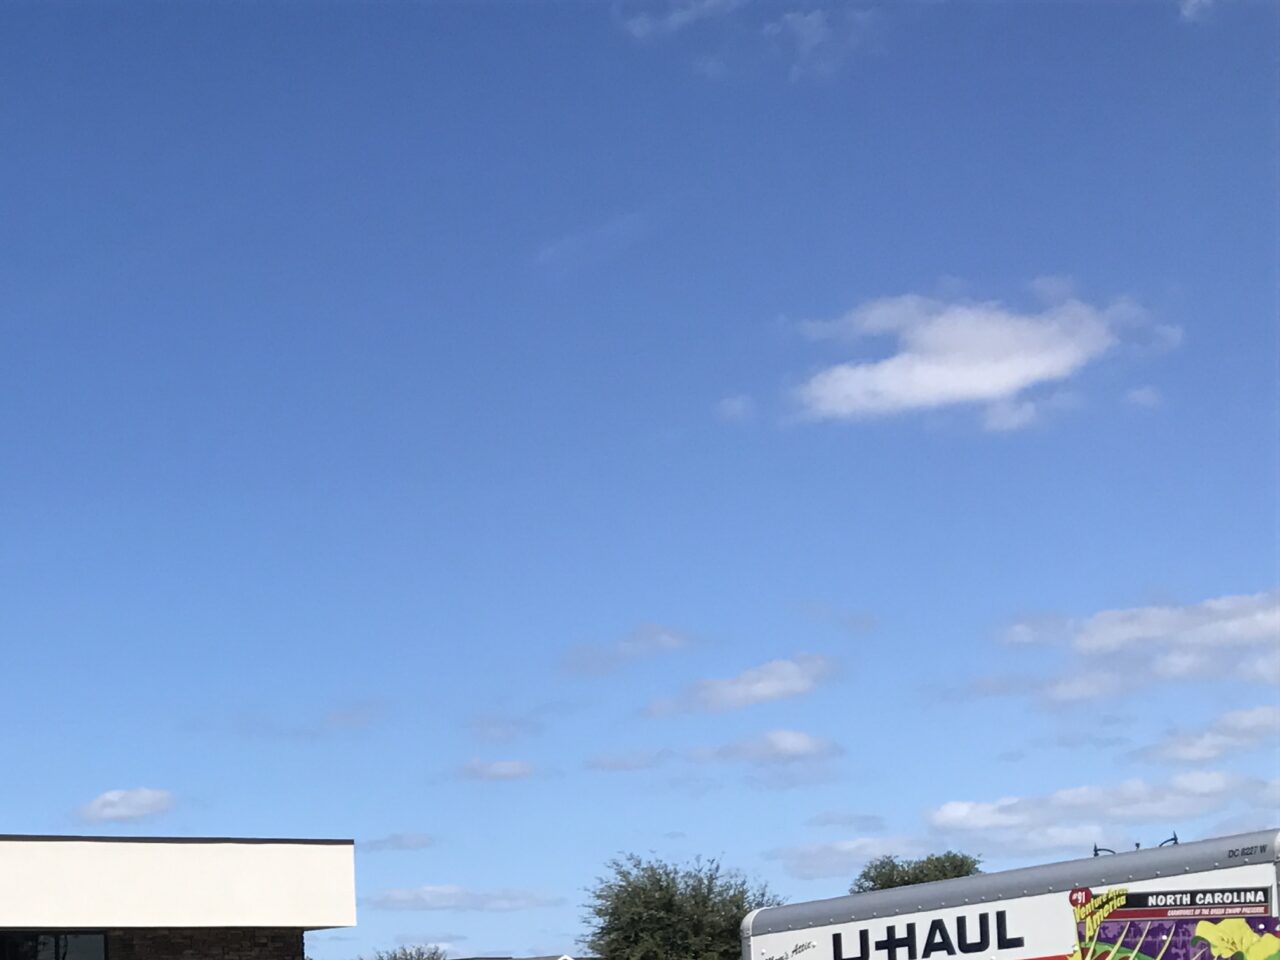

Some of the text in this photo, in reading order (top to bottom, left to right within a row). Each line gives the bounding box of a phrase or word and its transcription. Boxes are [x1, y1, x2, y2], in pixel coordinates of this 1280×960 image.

[1228, 848, 1239, 858] DC
[1148, 891, 1265, 907] NORTH CAROLINA
